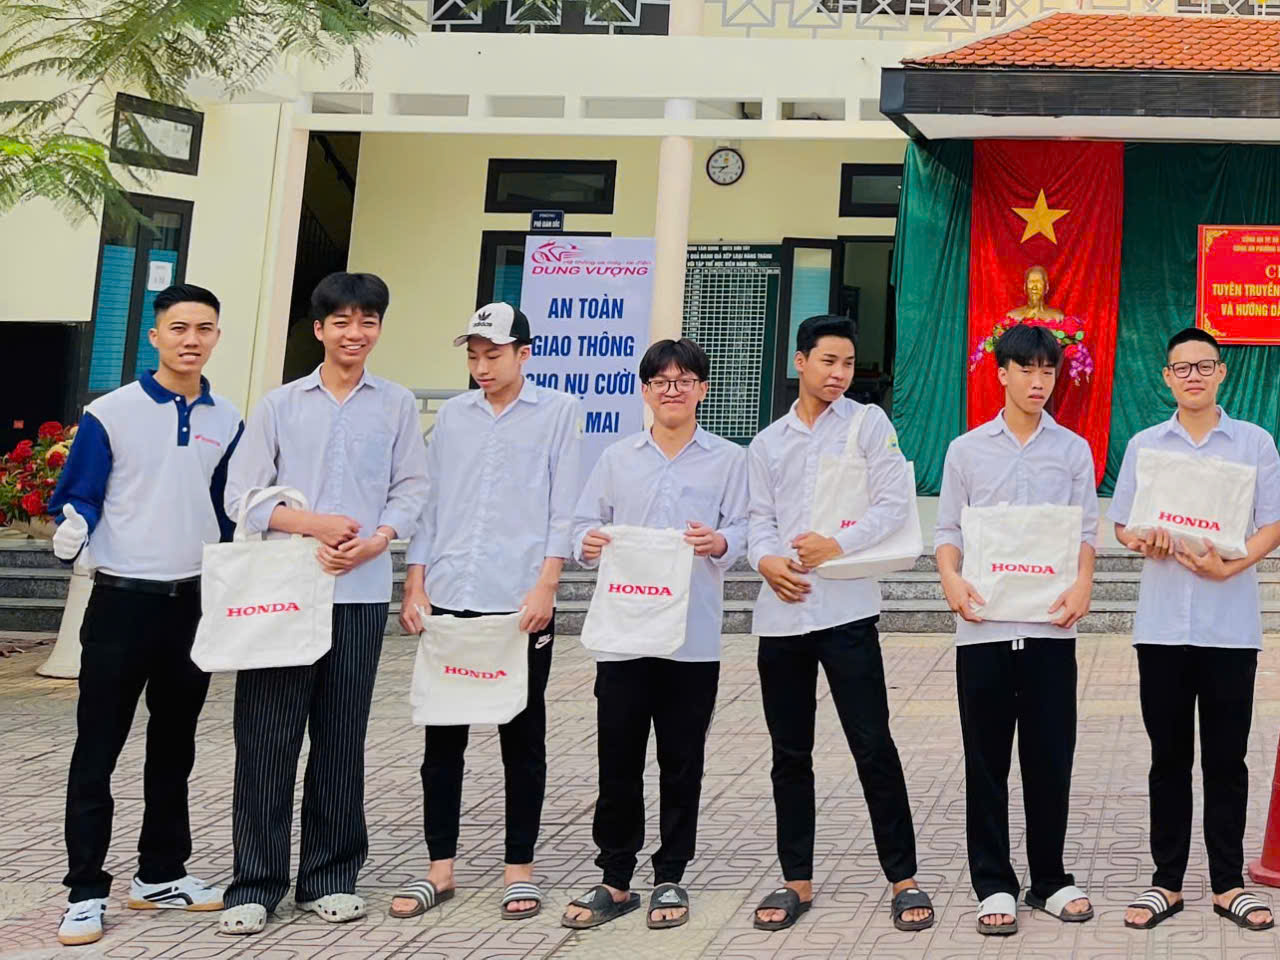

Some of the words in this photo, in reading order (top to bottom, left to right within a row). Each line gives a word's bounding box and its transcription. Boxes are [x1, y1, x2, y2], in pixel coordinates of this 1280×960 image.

[585, 265, 649, 277] VƯỢNG
[1212, 281, 1242, 296] TUYÊN
[1244, 281, 1280, 297] TRUYỀN
[548, 298, 573, 319] AN
[579, 293, 624, 319] TOÀN
[1221, 301, 1234, 316] VÀ
[531, 335, 572, 357] GIAO
[578, 331, 635, 357] THÔNG
[564, 374, 589, 400] NỤ
[594, 368, 636, 395] CƯỜI
[585, 411, 620, 433] MAI
[1158, 511, 1221, 532] HONDA
[991, 563, 1055, 575] HONDA
[608, 583, 673, 597] HONDA
[227, 602, 300, 617] HONDA
[444, 665, 507, 679] HONDA
